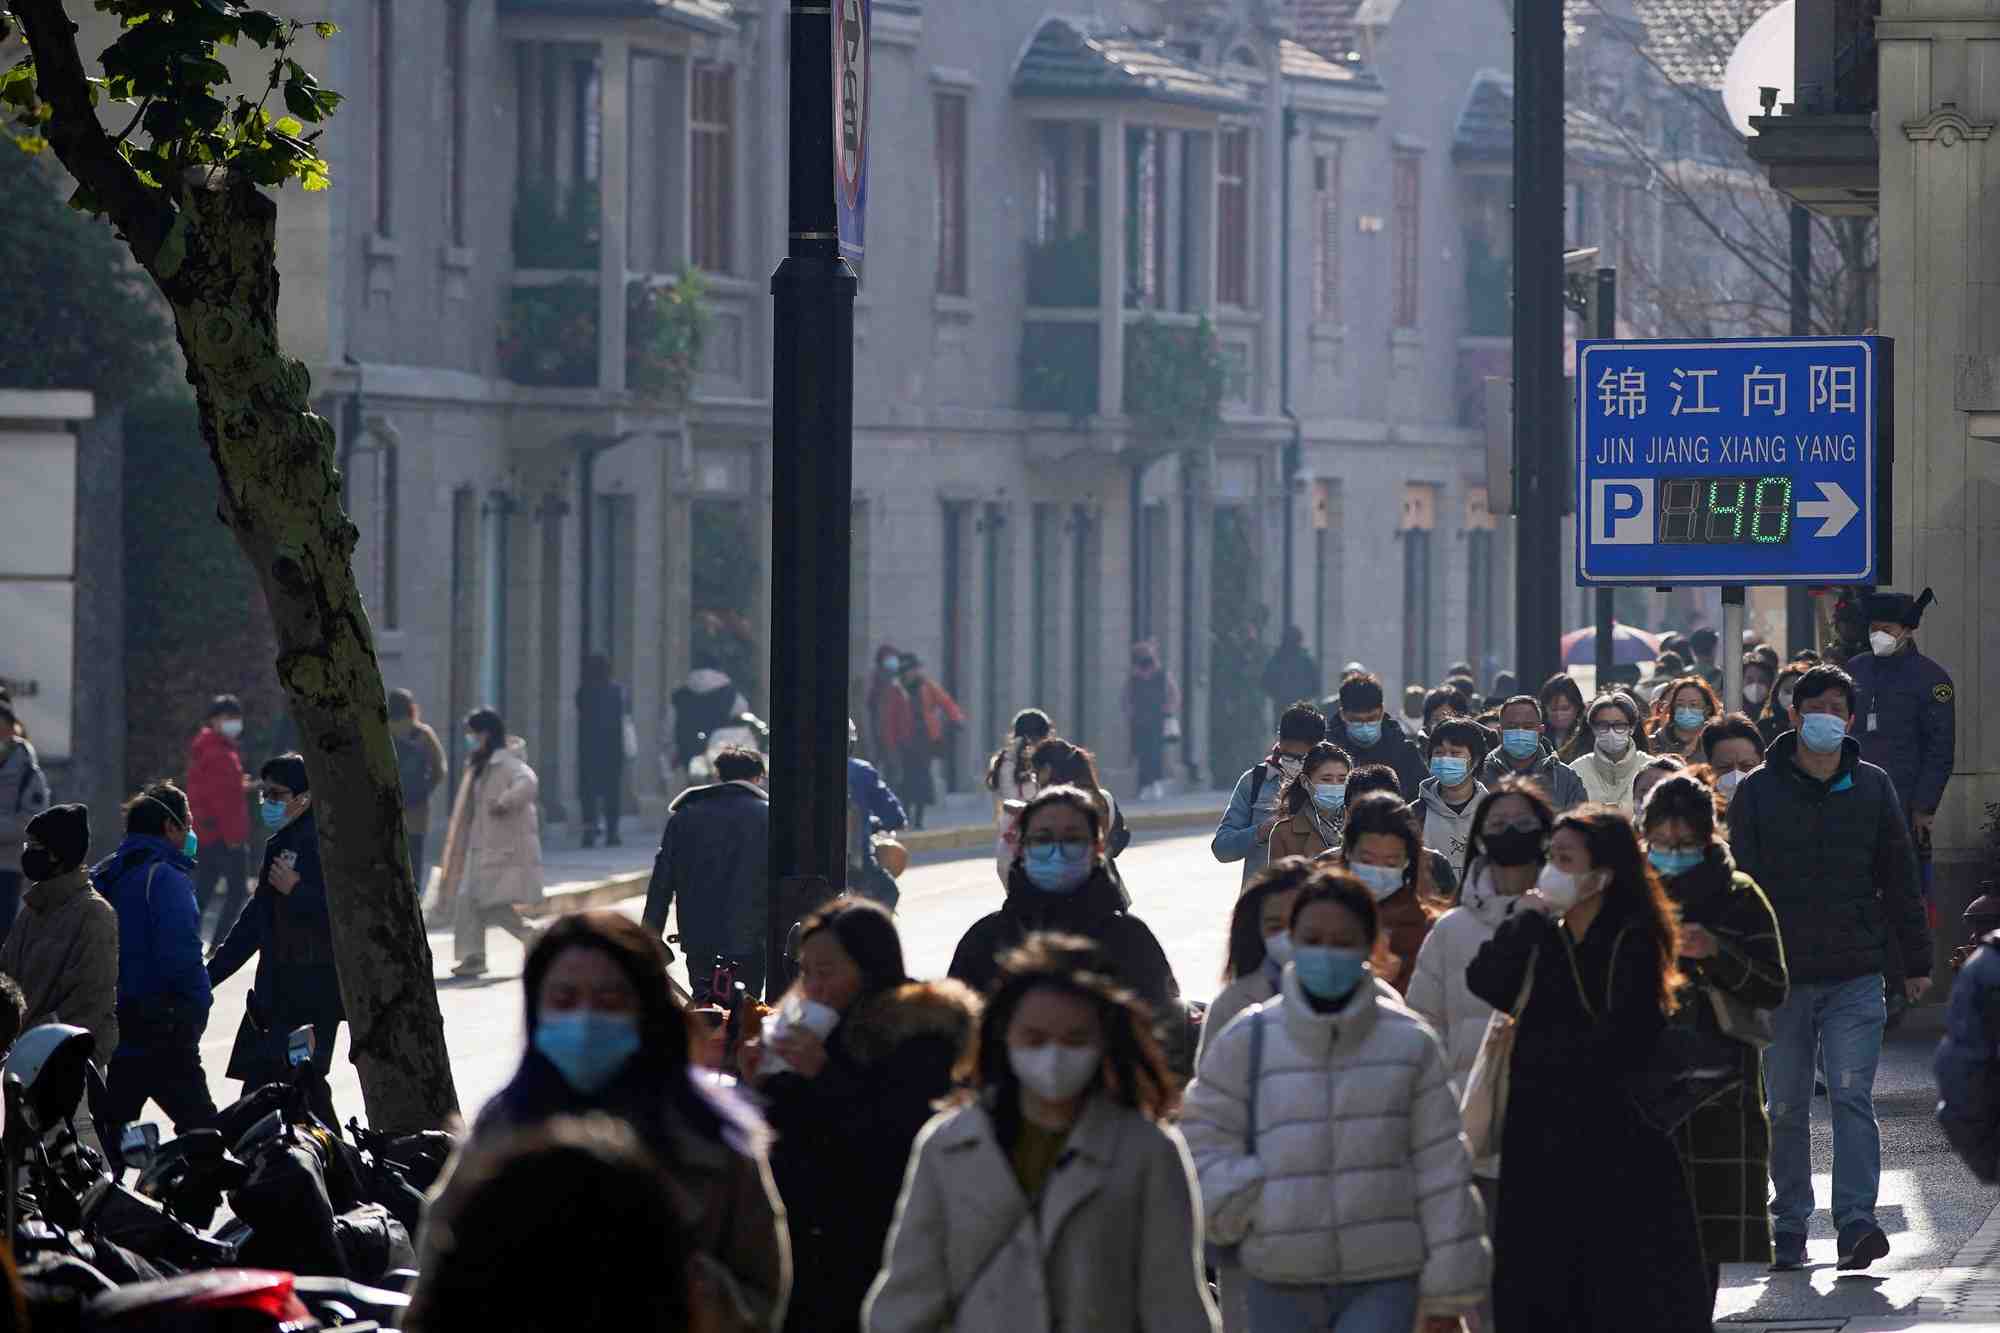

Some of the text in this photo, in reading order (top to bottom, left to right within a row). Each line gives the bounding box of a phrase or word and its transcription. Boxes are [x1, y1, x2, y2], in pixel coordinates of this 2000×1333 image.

[1597, 365, 1856, 420] 锦江向阳
[1596, 434, 1857, 464] JIN JIANG XIANG YANG
[1603, 484, 1644, 539] P
[1708, 477, 1792, 543] 40
